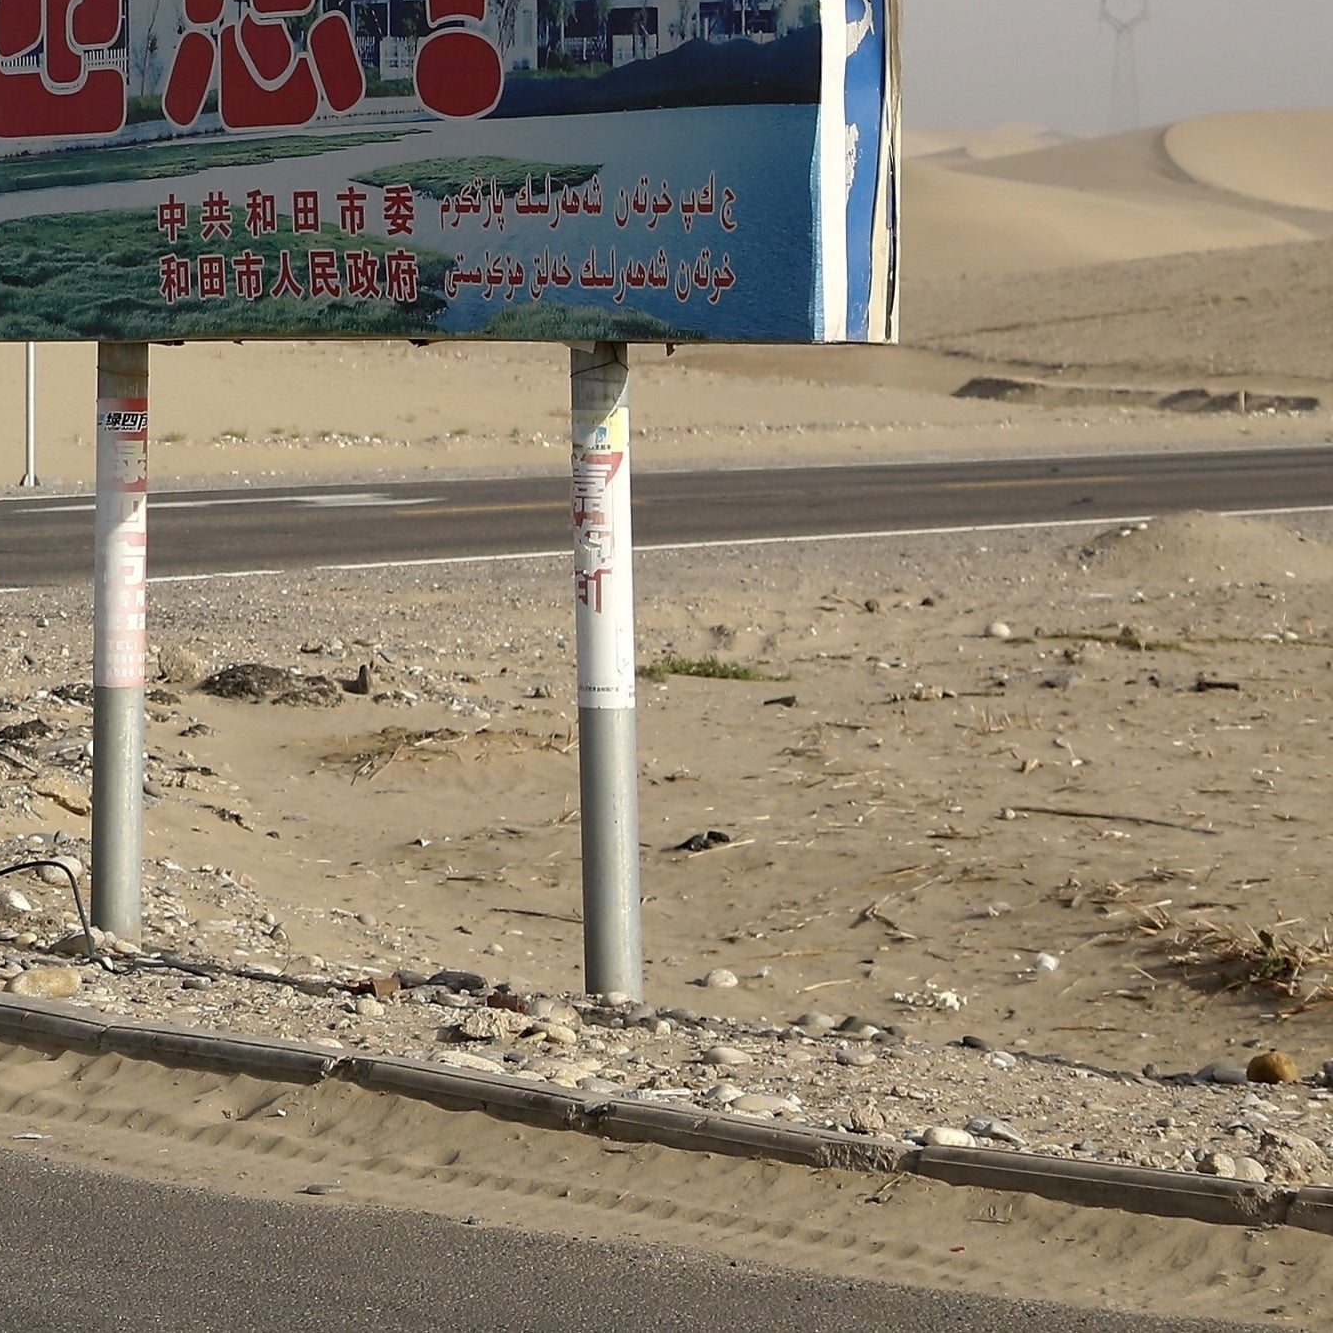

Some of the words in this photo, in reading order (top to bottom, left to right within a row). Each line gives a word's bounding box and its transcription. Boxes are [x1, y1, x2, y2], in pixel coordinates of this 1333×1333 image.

[157, 183, 416, 244] 中共和田市委
[159, 248, 418, 305] 和田市人民政府
